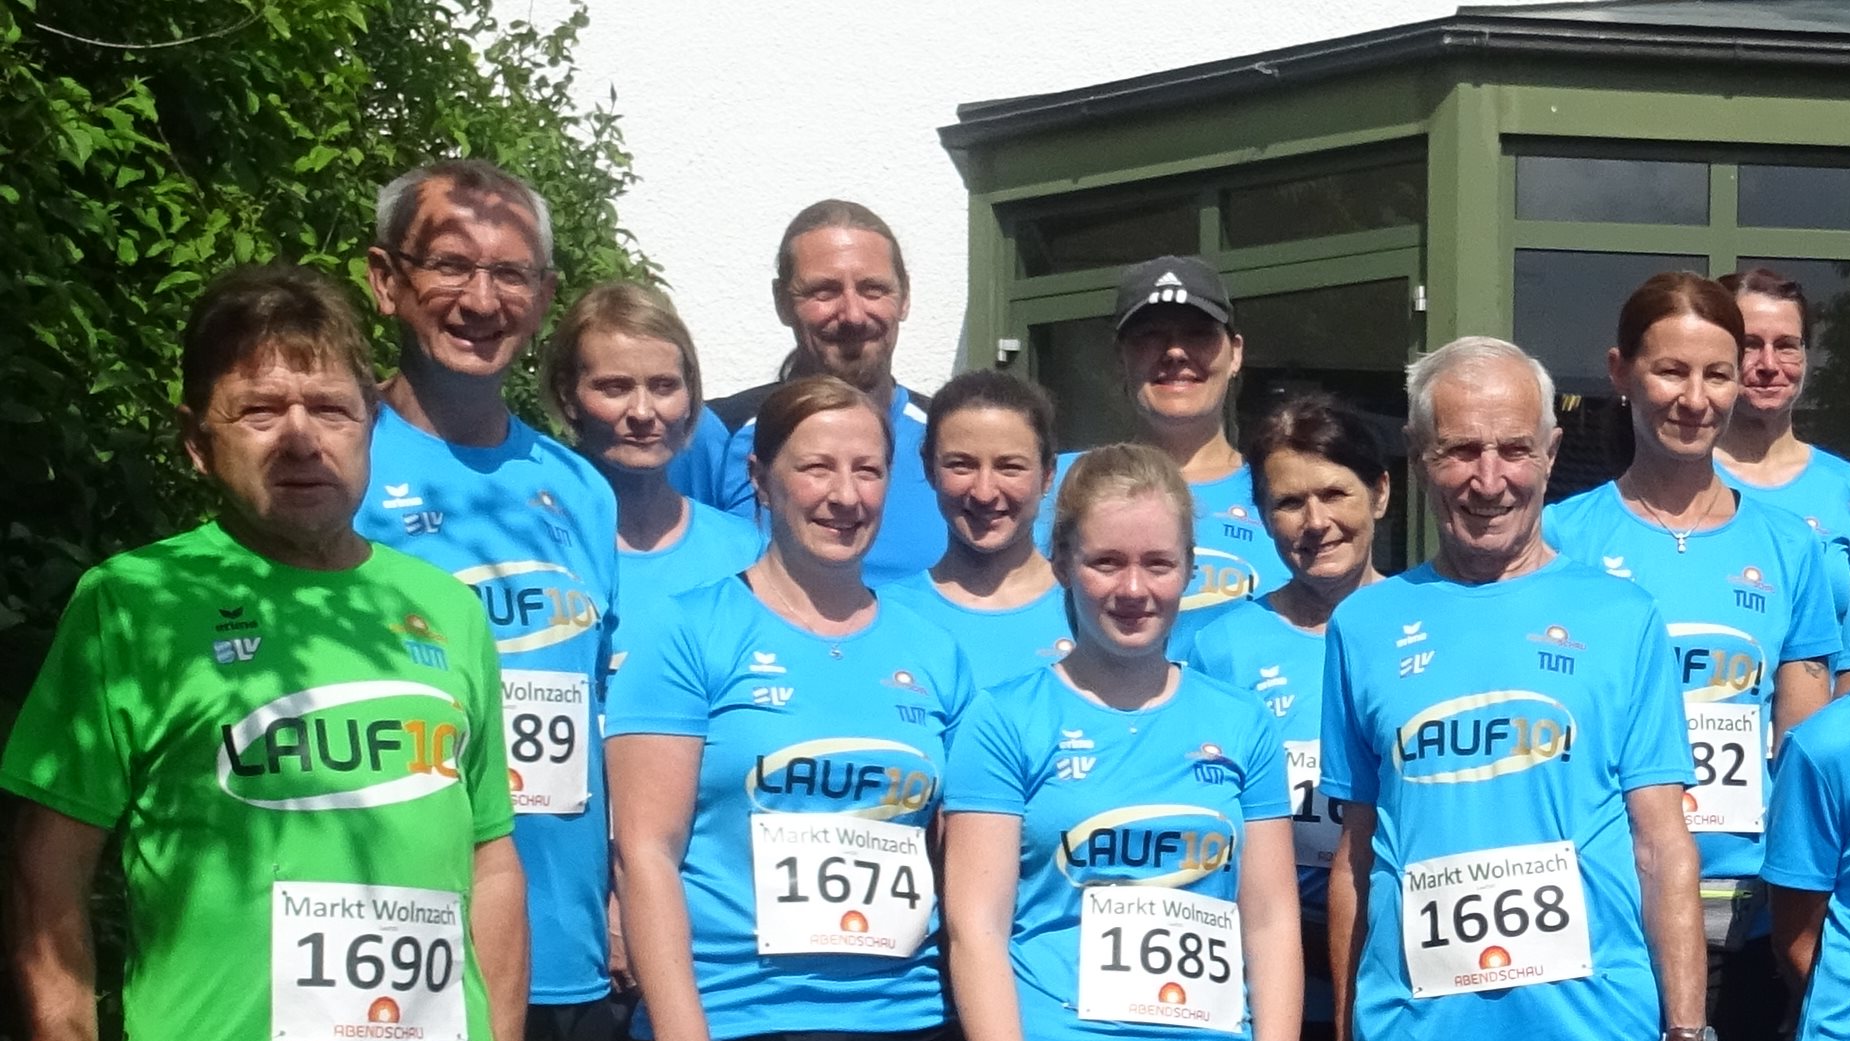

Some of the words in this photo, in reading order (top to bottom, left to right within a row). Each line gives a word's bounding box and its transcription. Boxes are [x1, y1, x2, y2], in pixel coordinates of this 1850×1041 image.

[1733, 589, 1766, 613] TUM
[213, 636, 261, 664] BLV
[1538, 651, 1575, 675] TUM
[1396, 717, 1572, 763] LAUF10!
[756, 755, 937, 811] LAUF10!
[763, 826, 831, 845] Markt
[836, 827, 918, 856] Wolnzach
[1060, 828, 1235, 872] LAUF10!
[775, 856, 921, 909] 1674
[1409, 867, 1463, 892] Markt
[1468, 853, 1568, 881] Wolnzach
[285, 897, 365, 919] Markt
[372, 899, 456, 926] Wolnzach
[1092, 897, 1156, 916] Markt
[1163, 900, 1233, 930] Wolnzach
[1420, 885, 1570, 949] 1668
[810, 934, 896, 950] ABENDSCHAU
[1100, 926, 1231, 984] 1685
[297, 932, 453, 993] 1690
[1454, 965, 1544, 987] ABENDSCHAU
[1129, 1004, 1211, 1022] ABENDSCHAU
[333, 1024, 424, 1040] ABENDSCHAU
